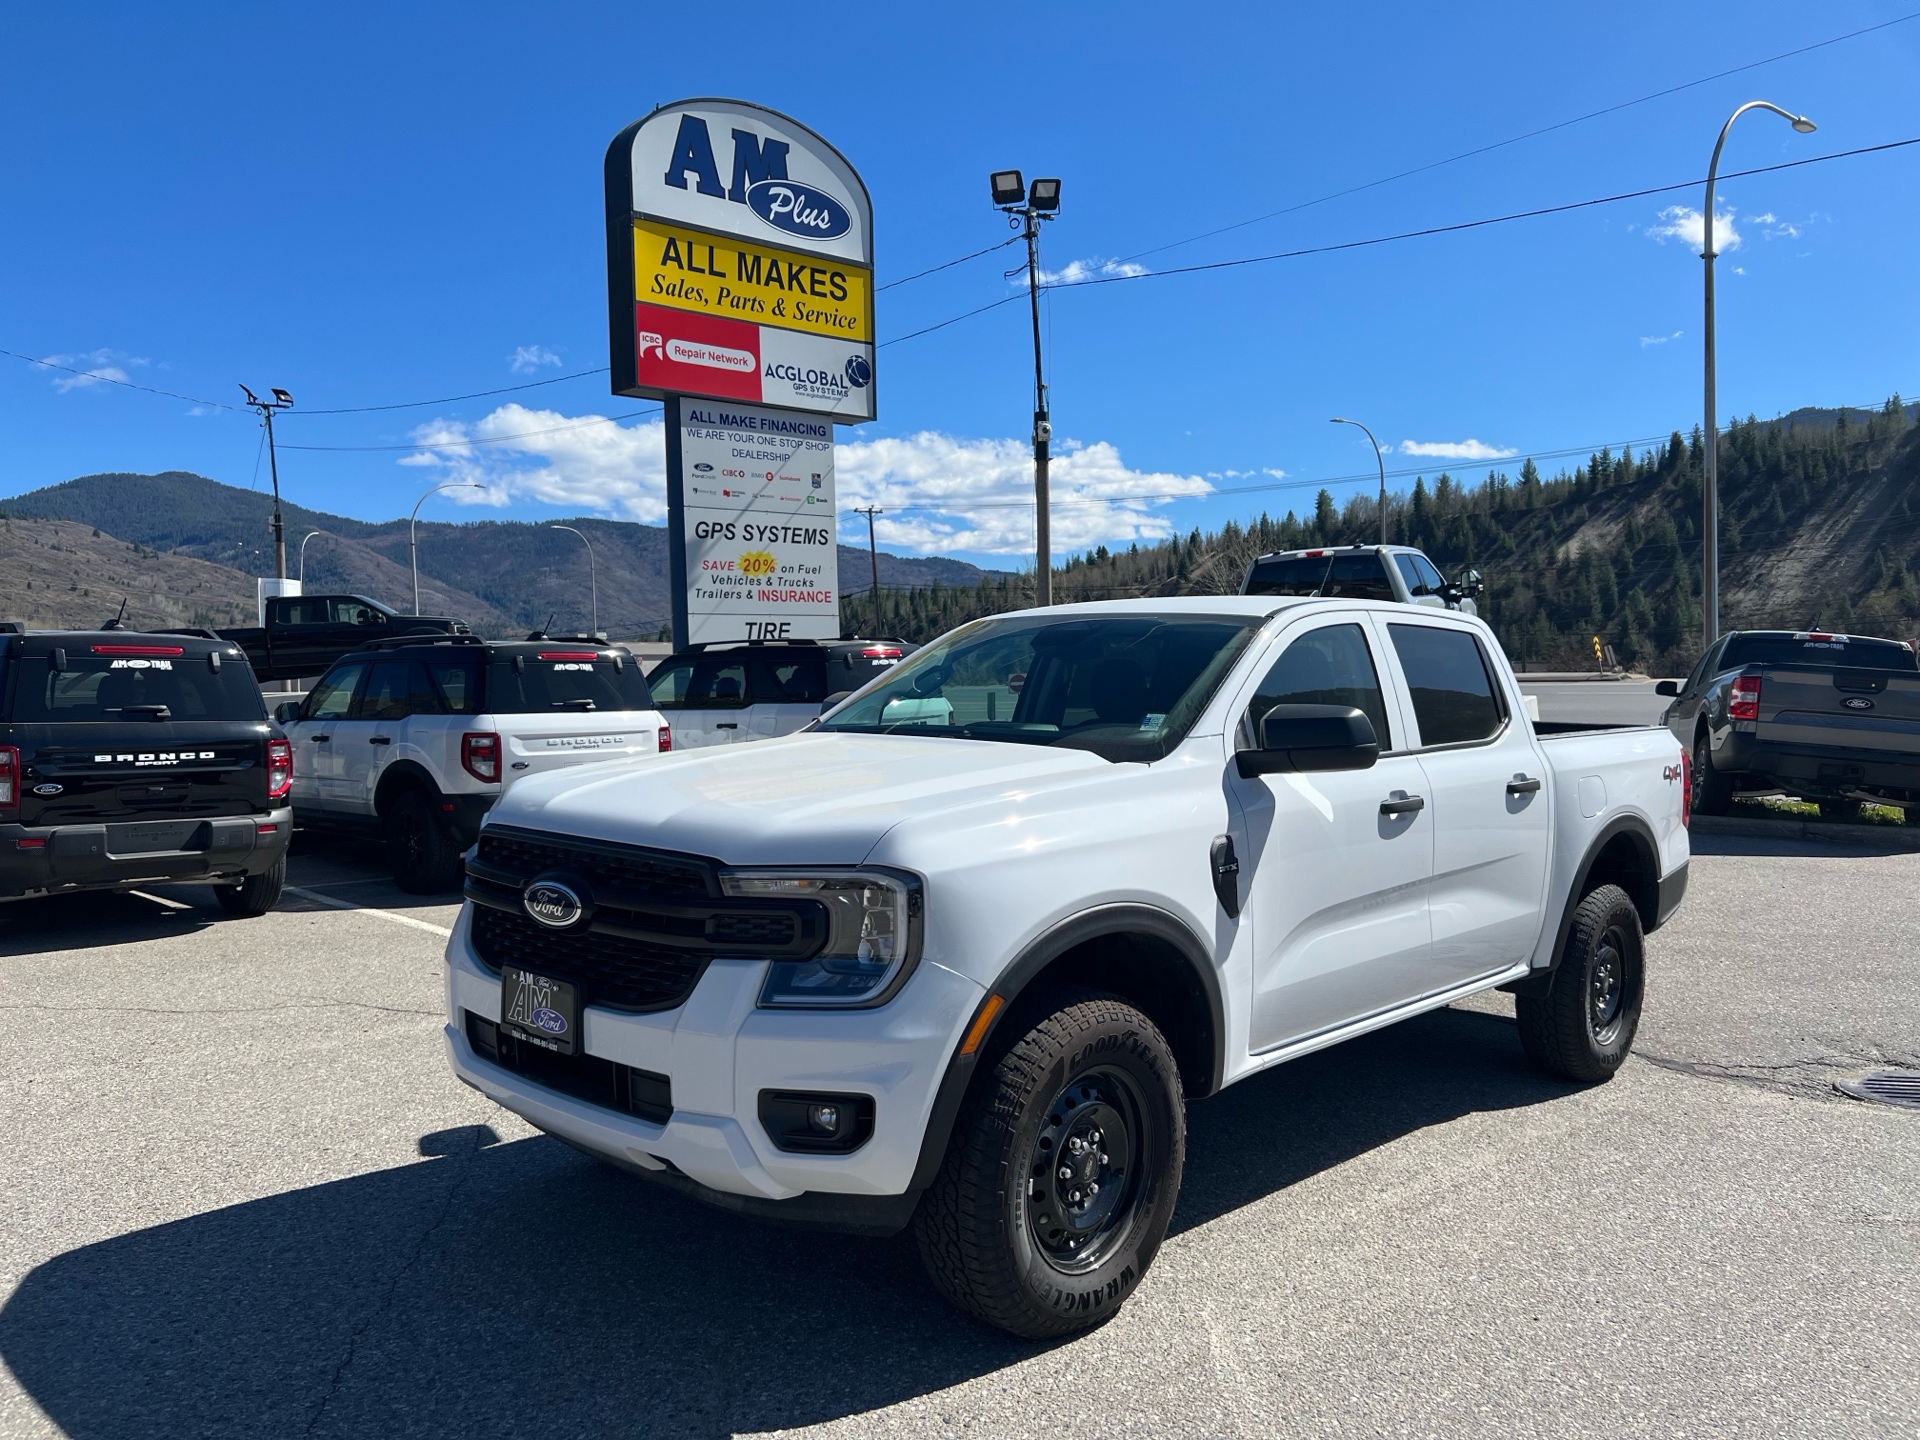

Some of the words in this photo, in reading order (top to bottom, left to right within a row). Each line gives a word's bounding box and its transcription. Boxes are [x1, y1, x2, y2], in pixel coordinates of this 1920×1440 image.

[664, 113, 790, 205] AM
[768, 187, 831, 230] Plus
[660, 237, 726, 278] ALL
[737, 252, 848, 301] MAKES
[651, 273, 709, 307] Sales,
[716, 286, 766, 313] Parts
[771, 297, 787, 318] &
[792, 302, 857, 330] Service
[641, 334, 660, 344] ICBC
[674, 345, 706, 360] Repair
[708, 351, 749, 367] Network
[764, 363, 849, 389] ACGLOBAL
[792, 382, 808, 392] GPS
[809, 385, 849, 398] SYSTEMS
[690, 410, 716, 424] ALL
[720, 413, 757, 429] MAKE
[761, 418, 827, 437] FINANCING
[687, 428, 703, 438] WE
[705, 430, 725, 441] ARE
[727, 432, 755, 444] YOUR
[757, 436, 777, 447] ONE
[779, 438, 803, 449] STOP
[805, 441, 830, 452] SHOP
[732, 448, 791, 463] DEALERSHIP
[722, 469, 739, 477] CIBC
[695, 521, 736, 541] GPS
[742, 524, 829, 546] SYSTEMS
[702, 560, 735, 571] SAVE
[743, 558, 776, 574] 20%
[781, 566, 795, 574] on
[798, 564, 822, 575] Fuel
[711, 575, 762, 586] Vehicles
[766, 577, 773, 586] &
[777, 576, 815, 588] Trucks
[695, 588, 742, 600] Trailers
[746, 590, 753, 600] &
[757, 589, 832, 604] INSURANCE
[745, 622, 791, 640] TIRE
[110, 660, 128, 668] AM
[150, 660, 173, 670] TRAIL
[546, 737, 624, 747] BRONCO
[94, 752, 215, 762] BRONCO
[1219, 862, 1238, 873] STX
[533, 889, 564, 917] Ford
[519, 970, 534, 985] AM
[538, 977, 550, 988] Ford
[508, 982, 550, 1027] AM
[538, 1010, 561, 1031] Ford
[1029, 1264, 1136, 1313] WRANGLER
